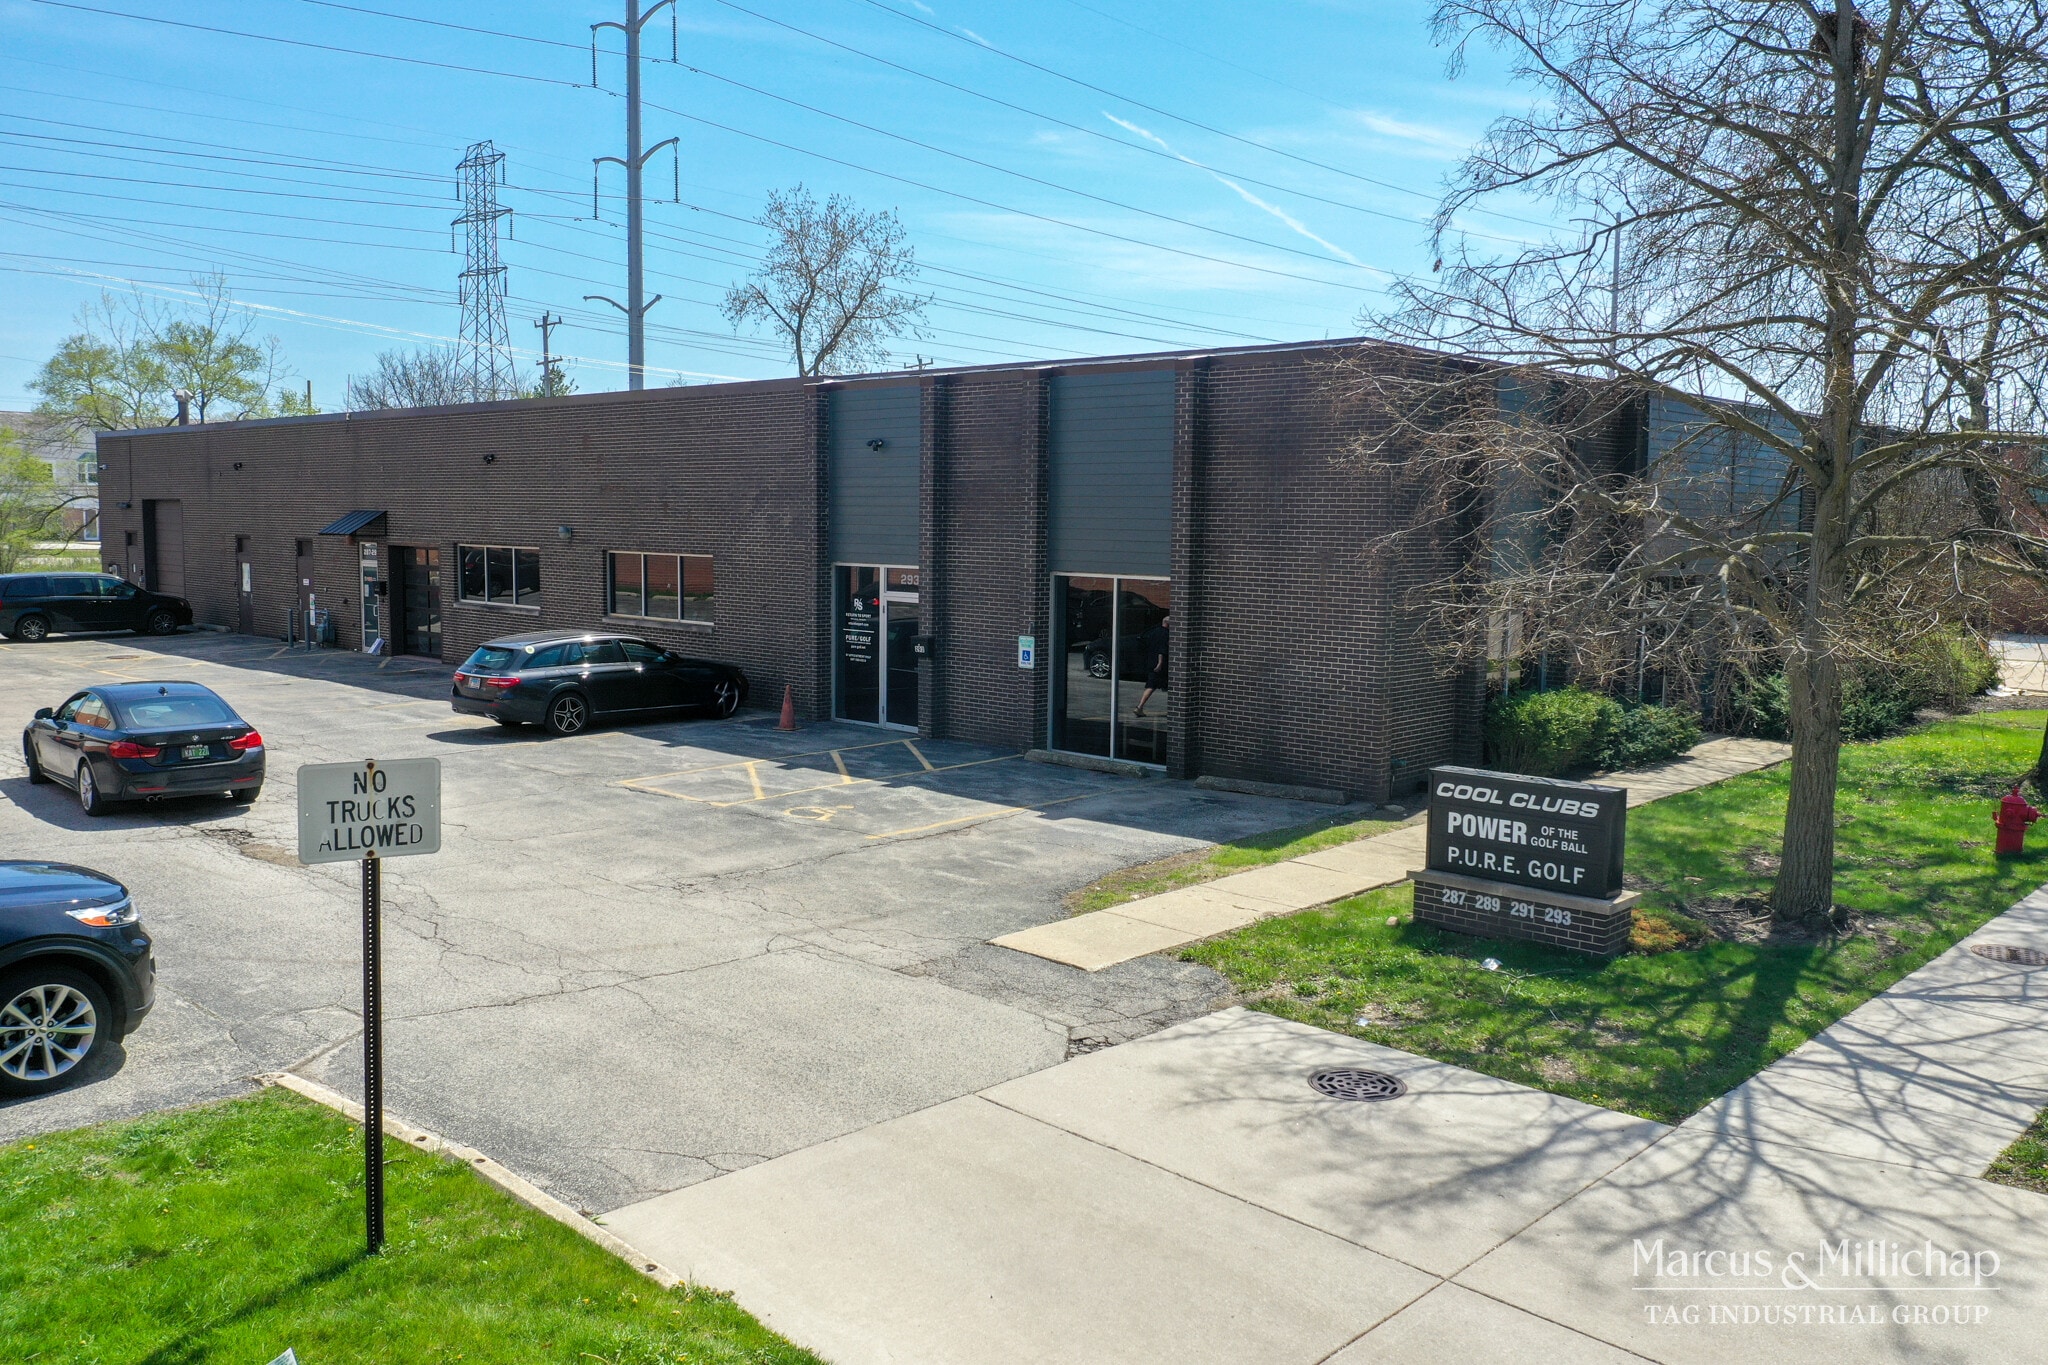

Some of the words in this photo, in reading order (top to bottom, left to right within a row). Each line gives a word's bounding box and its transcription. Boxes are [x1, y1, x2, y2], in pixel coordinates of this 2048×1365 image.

[901, 574, 919, 586] 293
[353, 770, 387, 794] NO
[326, 795, 416, 824] TRUCKS
[1436, 782, 1503, 805] COOL
[1509, 792, 1600, 818] CLUBS
[319, 823, 423, 852] ALLOWED
[1447, 812, 1527, 845] POWER
[1540, 826, 1556, 837] OF
[1558, 828, 1578, 840] THE
[1530, 836, 1558, 849] GOLF
[1561, 841, 1588, 854] BALL
[1447, 846, 1521, 875] P.U.R.E.
[1528, 860, 1585, 884] GOLF
[1442, 888, 1466, 905] 287
[1475, 894, 1500, 912] 289
[1510, 901, 1535, 918] 291
[1544, 907, 1572, 925] 293
